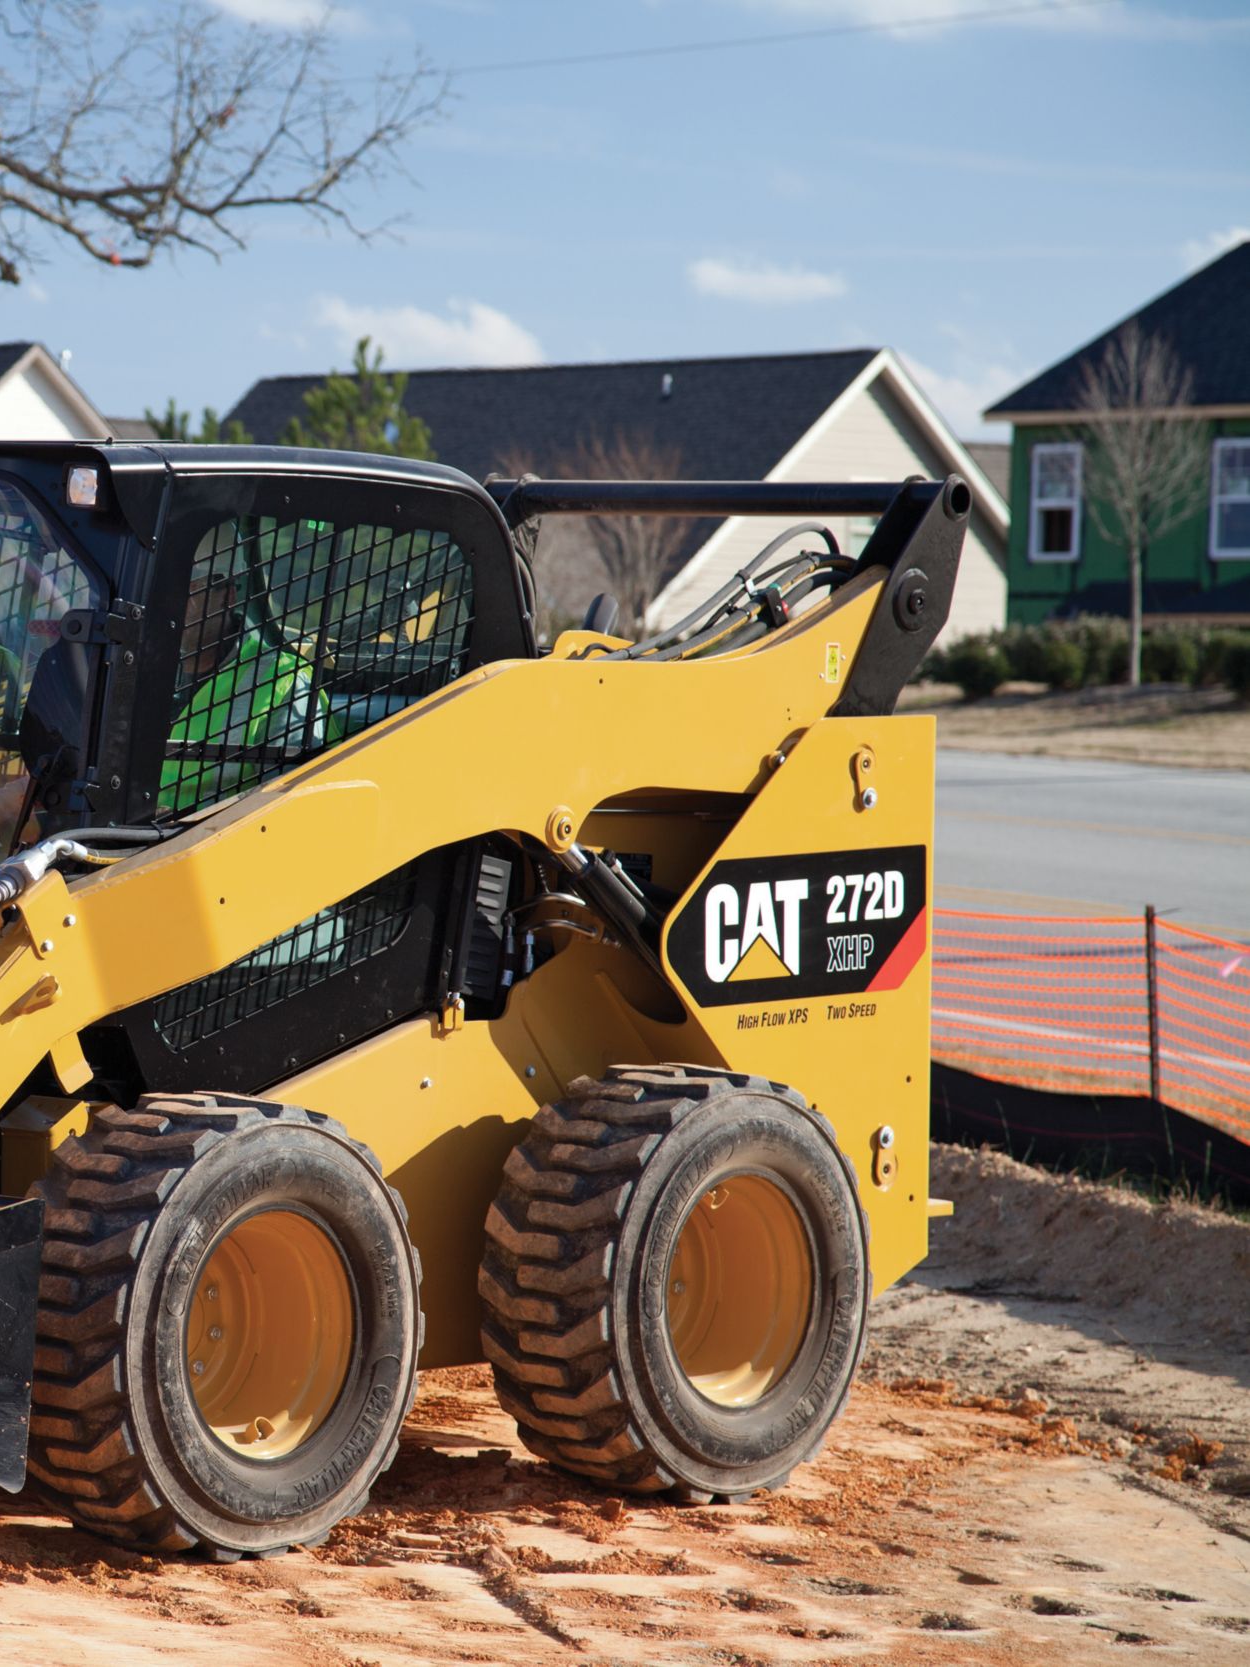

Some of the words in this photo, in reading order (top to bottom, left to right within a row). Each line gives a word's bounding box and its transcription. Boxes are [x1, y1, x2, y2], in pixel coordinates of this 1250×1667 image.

[826, 870, 904, 924] 272D
[705, 879, 808, 983] CAT
[826, 934, 874, 973] XHP
[788, 1008, 809, 1025] XPS
[293, 1384, 392, 1507] CATERPILLAR
